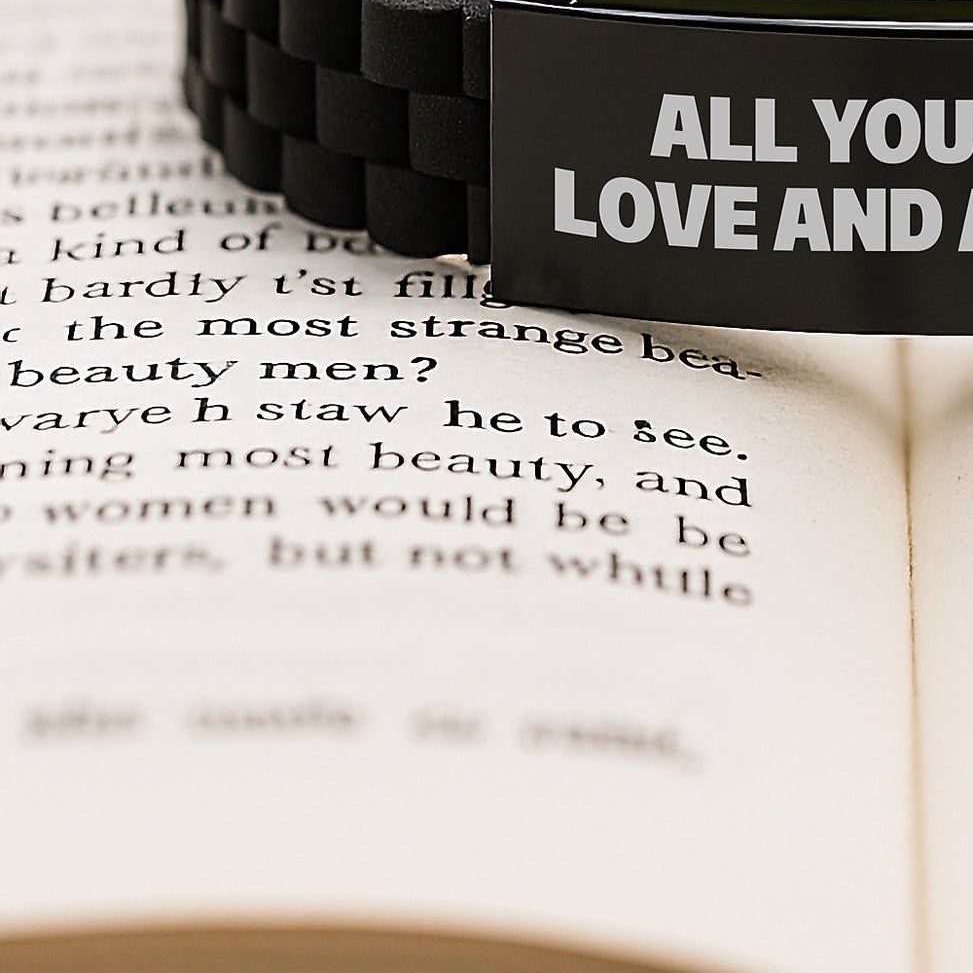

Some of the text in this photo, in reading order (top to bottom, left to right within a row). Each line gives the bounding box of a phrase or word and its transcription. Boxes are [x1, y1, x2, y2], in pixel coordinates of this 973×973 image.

[650, 93, 797, 163] ALL
[51, 228, 186, 261] kind
[219, 222, 281, 252] of
[554, 167, 758, 251] LOVE
[774, 186, 943, 252] AND
[9, 355, 438, 388] beauty men?
[66, 315, 165, 341] the
[196, 314, 360, 338] most
[390, 315, 624, 355] strange
[641, 332, 763, 381] bea-
[191, 397, 233, 423] h
[443, 400, 524, 433] he
[545, 411, 606, 438] to
[176, 447, 341, 471] most
[370, 442, 606, 492] beauty,
[635, 469, 751, 508] and
[43, 494, 277, 523] women
[319, 493, 516, 526] would
[555, 502, 631, 535] be
[676, 515, 751, 557] be
[268, 536, 377, 571] but
[408, 545, 517, 570] not
